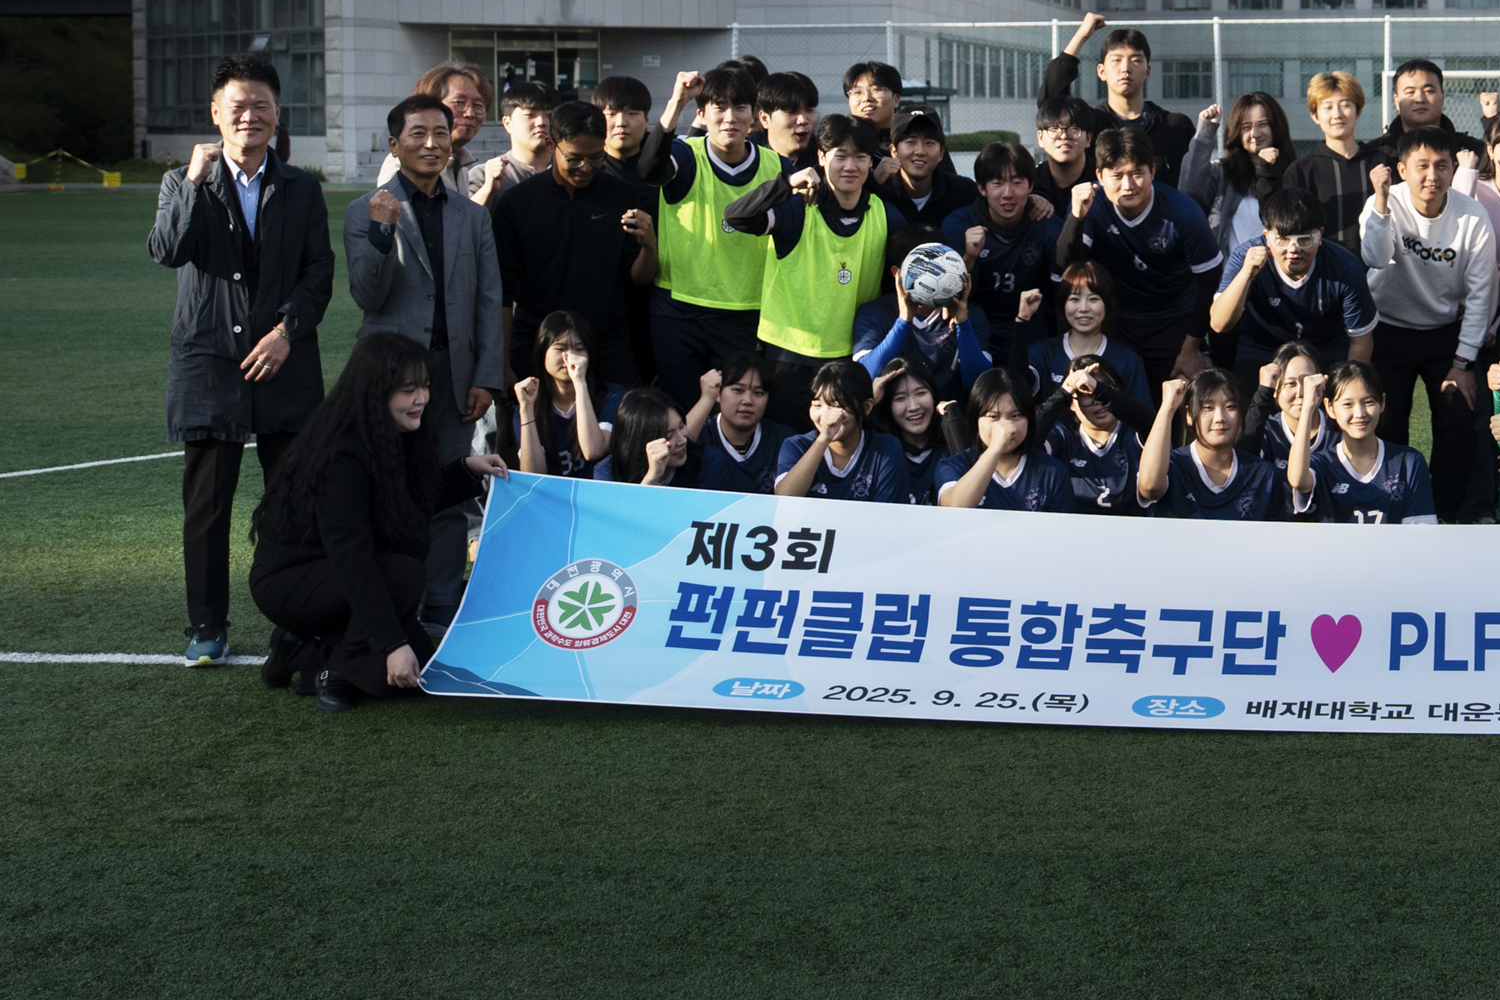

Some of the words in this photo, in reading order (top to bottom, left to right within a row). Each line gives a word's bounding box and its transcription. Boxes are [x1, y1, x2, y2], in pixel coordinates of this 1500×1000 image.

[686, 520, 836, 574] 제3회
[665, 581, 931, 663] 펀펀클럽
[949, 596, 1287, 676] 통합축구단
[729, 680, 793, 699] 날짜
[822, 684, 917, 706] 2025.
[930, 689, 962, 708] 9.
[974, 691, 1090, 714] 25.(목)
[1147, 698, 1208, 717] 장소
[1245, 699, 1416, 721] 배재대학교
